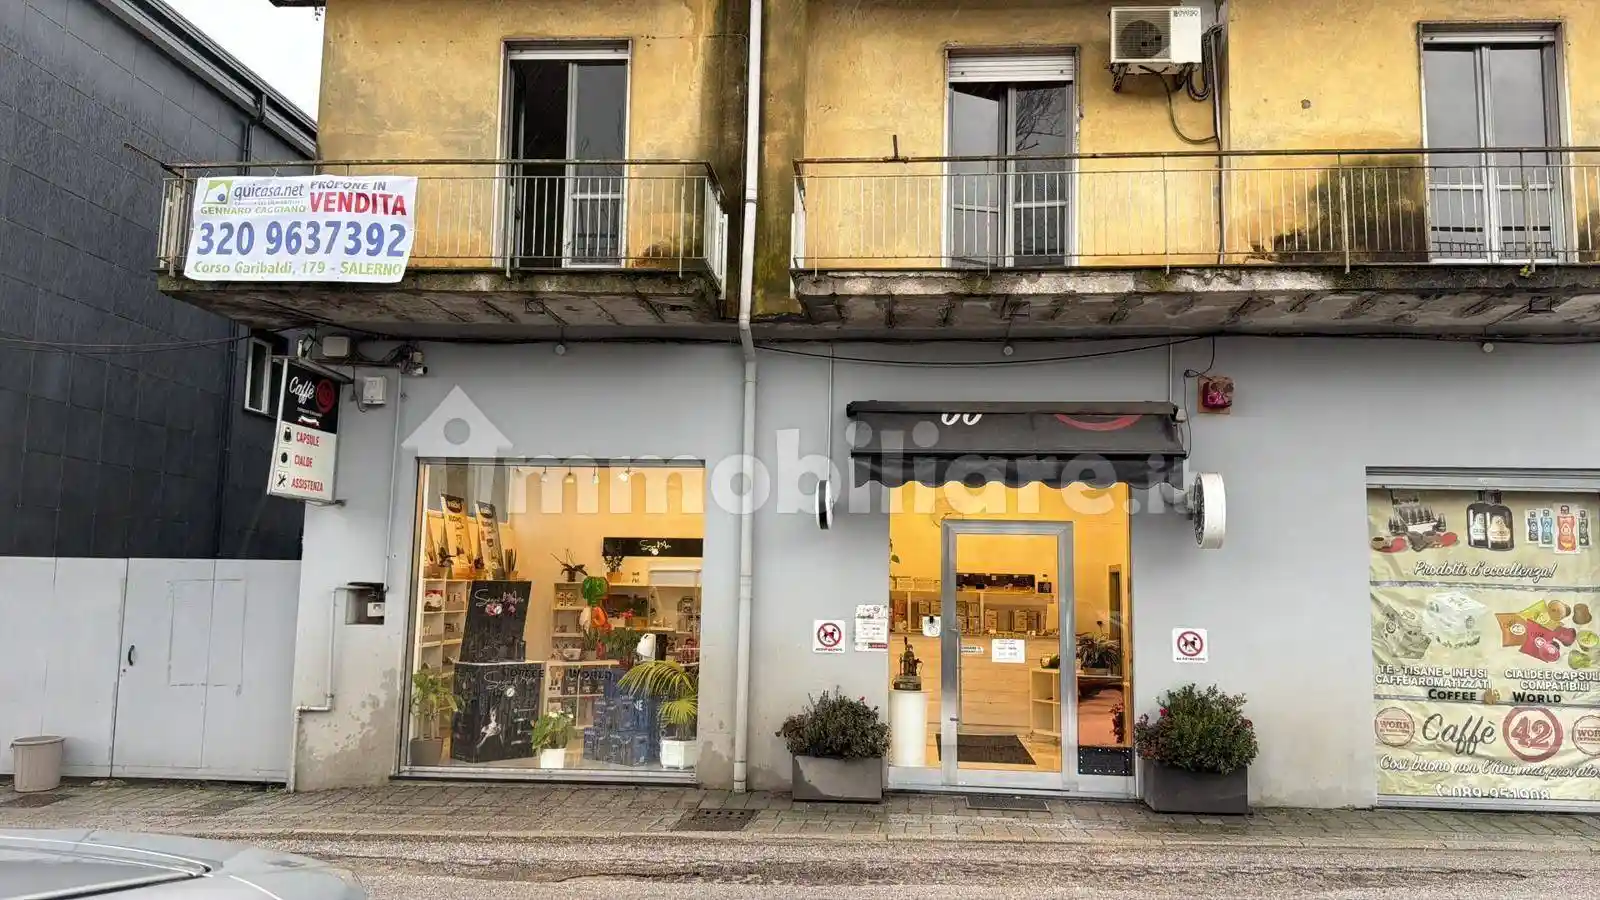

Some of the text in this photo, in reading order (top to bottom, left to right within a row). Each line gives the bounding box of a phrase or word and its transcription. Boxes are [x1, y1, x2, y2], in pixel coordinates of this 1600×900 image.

[234, 183, 304, 200] quicasa.net
[310, 180, 386, 191] PROPONE IN
[200, 205, 252, 215] GENNARO
[255, 204, 306, 214] CAGGIANO
[310, 191, 408, 216] VENDITA
[196, 220, 407, 257] 320 9637392
[194, 260, 230, 274] Corso
[234, 260, 296, 275] Garibaldi,
[301, 261, 325, 274] 179
[339, 261, 402, 276] SALERNO
[289, 376, 315, 404] Caffè
[296, 431, 320, 447] CAPSULE
[294, 454, 313, 468] CIALDE
[291, 477, 324, 492] ASSISTENZA
[1413, 560, 1558, 583] Prodotti d'eccellenza!
[1403, 665, 1444, 677] TISANE
[1452, 667, 1488, 679] INFUSI
[1504, 668, 1543, 681] CIALDE
[1552, 671, 1600, 682] CAPSUL
[1519, 680, 1590, 692] COMPATIBILI
[1427, 688, 1562, 704] COFFEE WORLD
[1421, 713, 1553, 755] Caffè 42
[1411, 755, 1451, 773] buono
[1452, 762, 1480, 774] non
